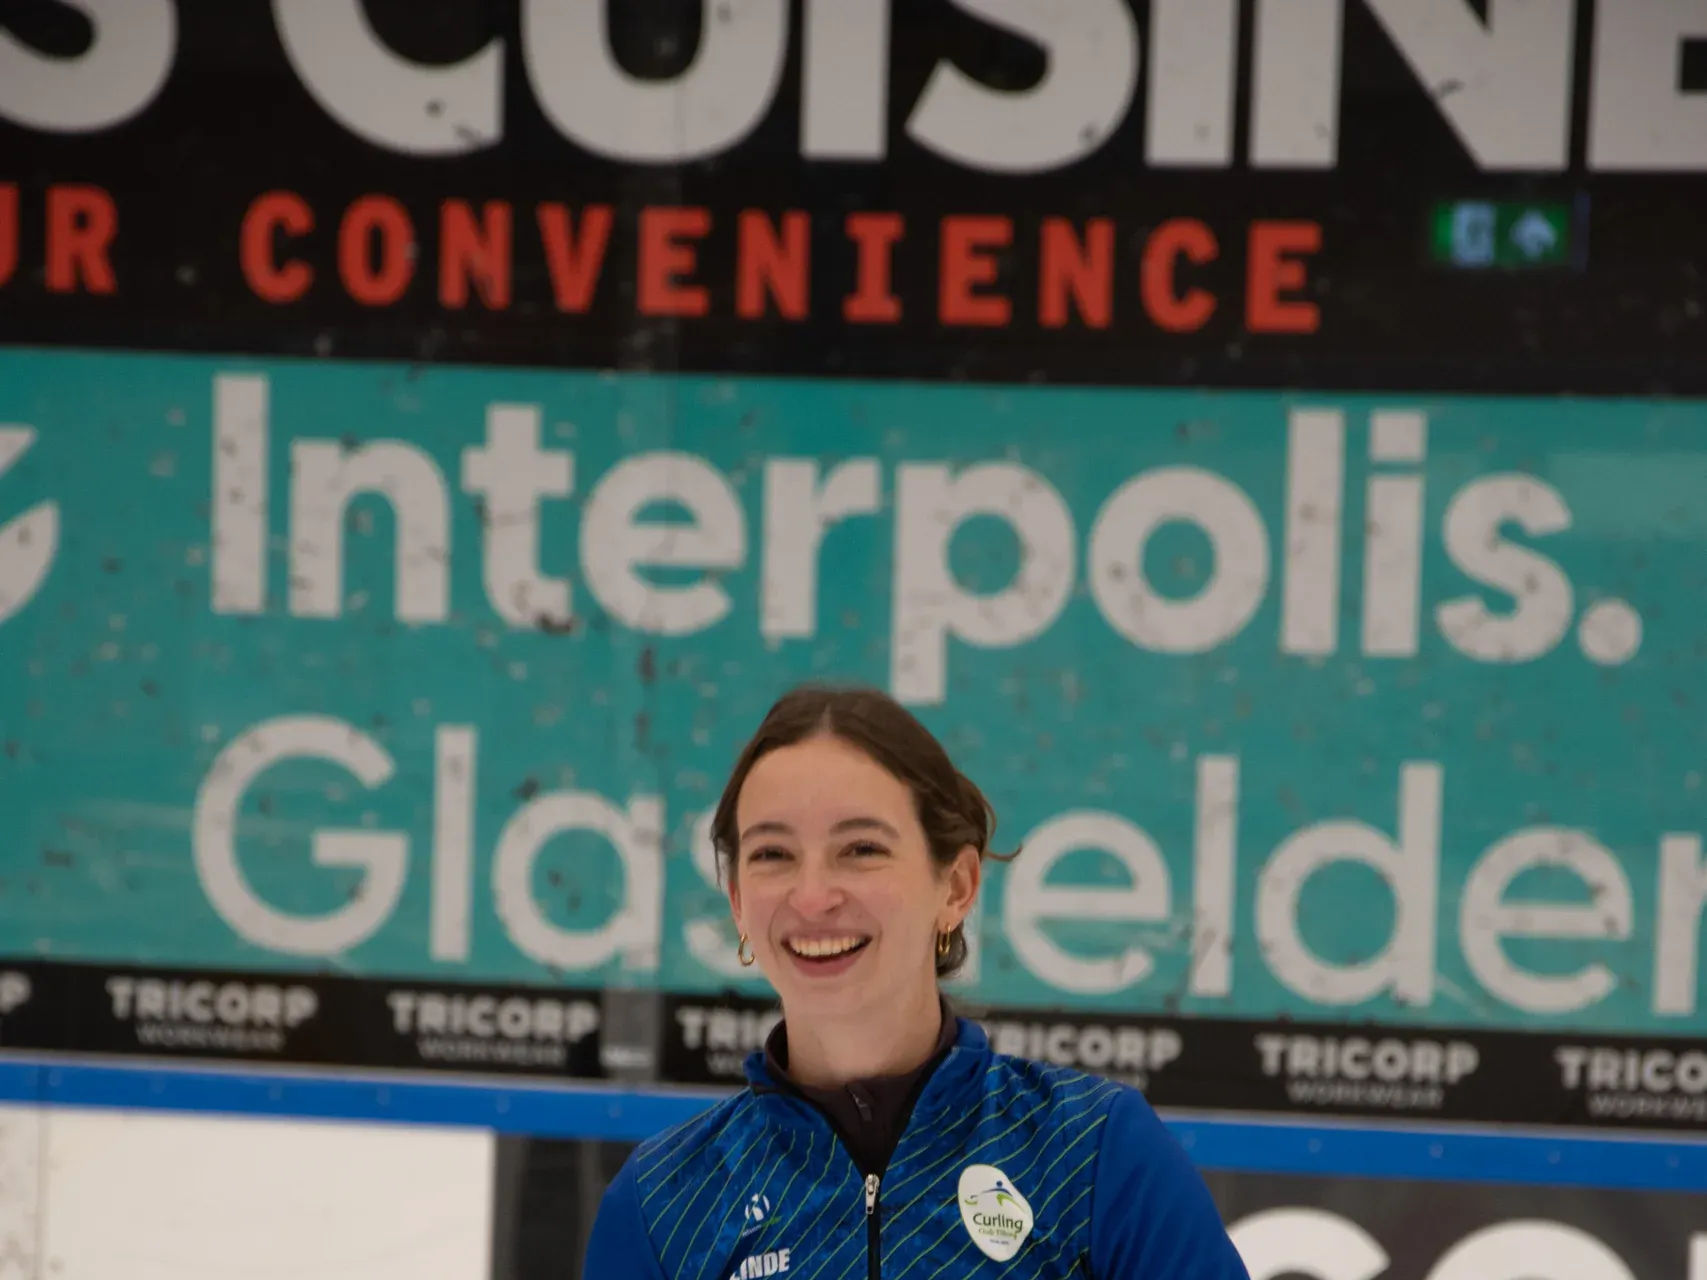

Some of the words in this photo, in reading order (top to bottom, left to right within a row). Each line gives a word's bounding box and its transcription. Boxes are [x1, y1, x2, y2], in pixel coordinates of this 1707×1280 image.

[240, 190, 1323, 334] CONVENIENCE
[211, 372, 1644, 706] Interpolis.
[191, 714, 1707, 1015] Glaselder
[105, 975, 319, 1028] TRICORP
[386, 990, 599, 1043] TRICORP
[1254, 1033, 1480, 1084] TRICORP
[972, 1212, 1024, 1234] Curling
